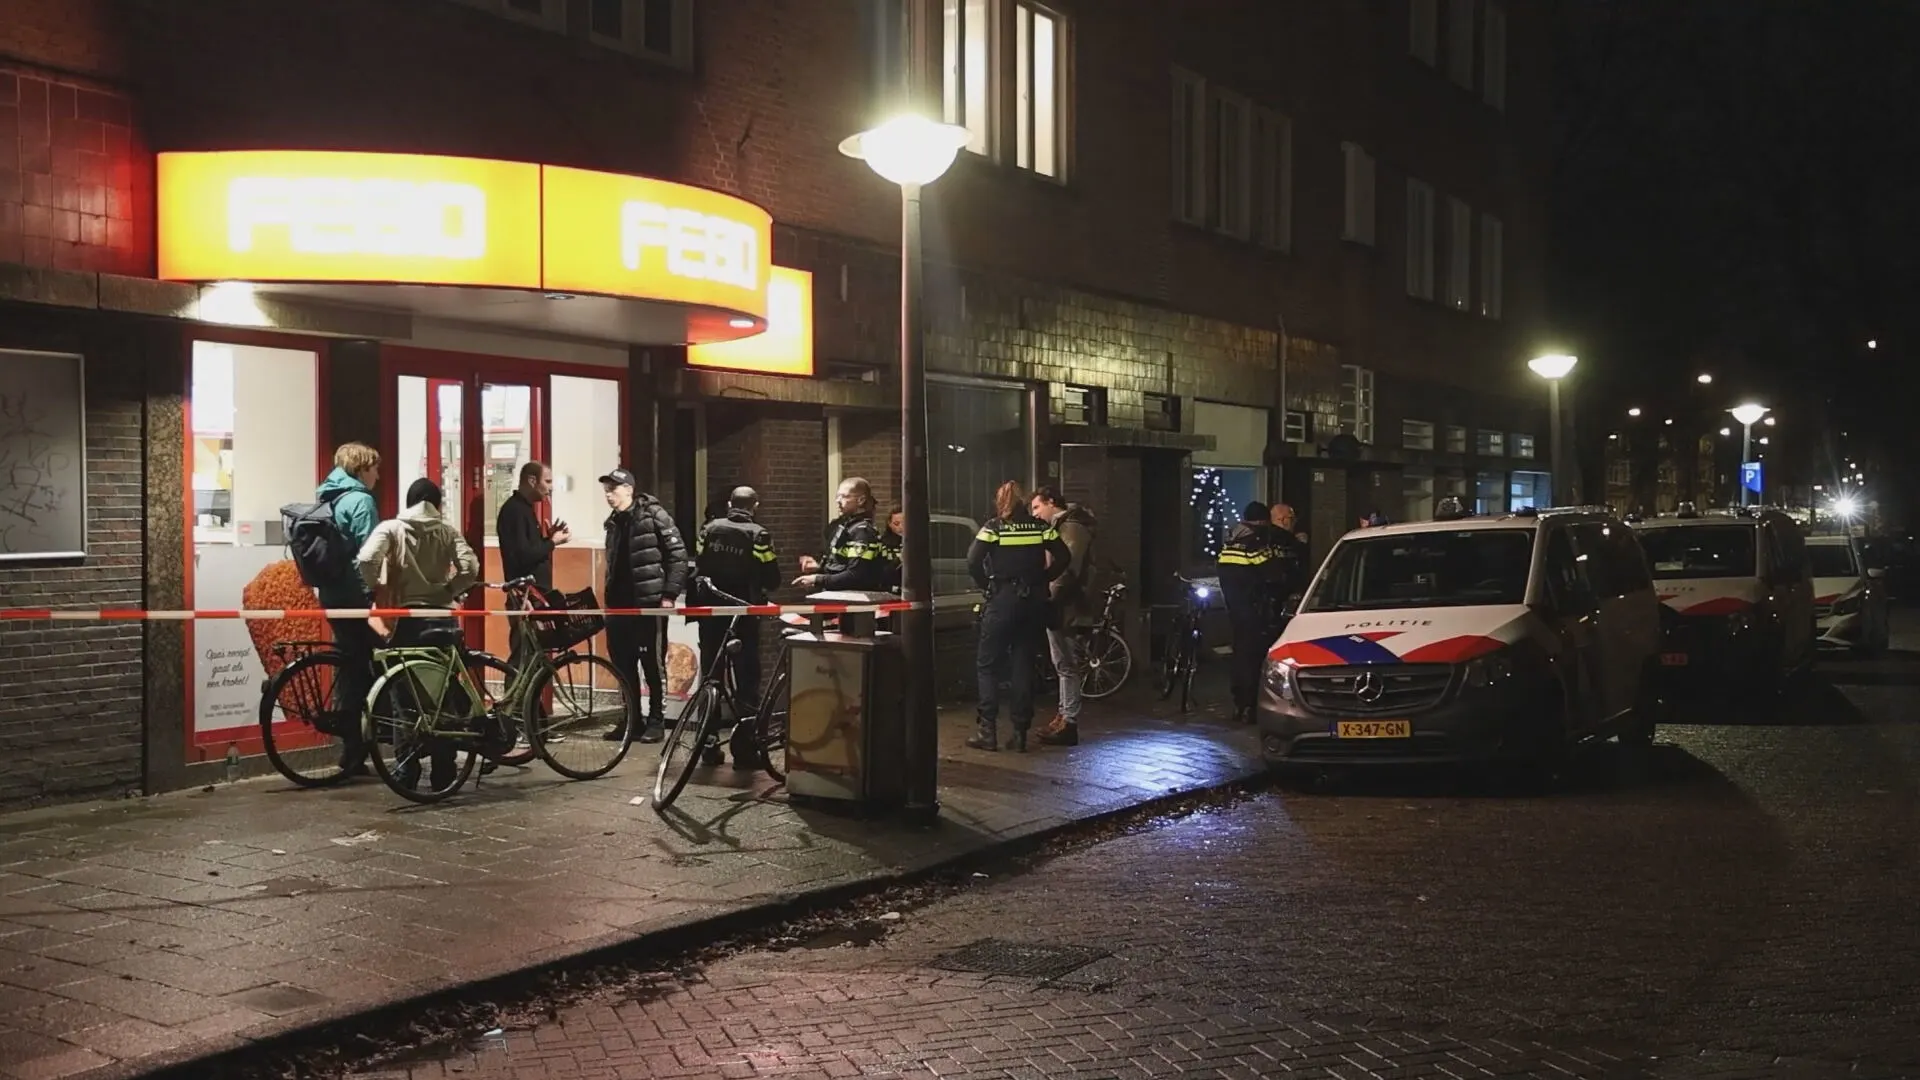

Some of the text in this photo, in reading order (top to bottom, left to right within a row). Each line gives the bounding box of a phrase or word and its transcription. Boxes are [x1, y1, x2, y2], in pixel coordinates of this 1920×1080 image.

[229, 177, 484, 258] FEBO
[622, 200, 757, 291] FEBO
[1745, 470, 1755, 483] P
[1344, 621, 1433, 629] POLITIE
[1342, 722, 1405, 737] X-347-GN
